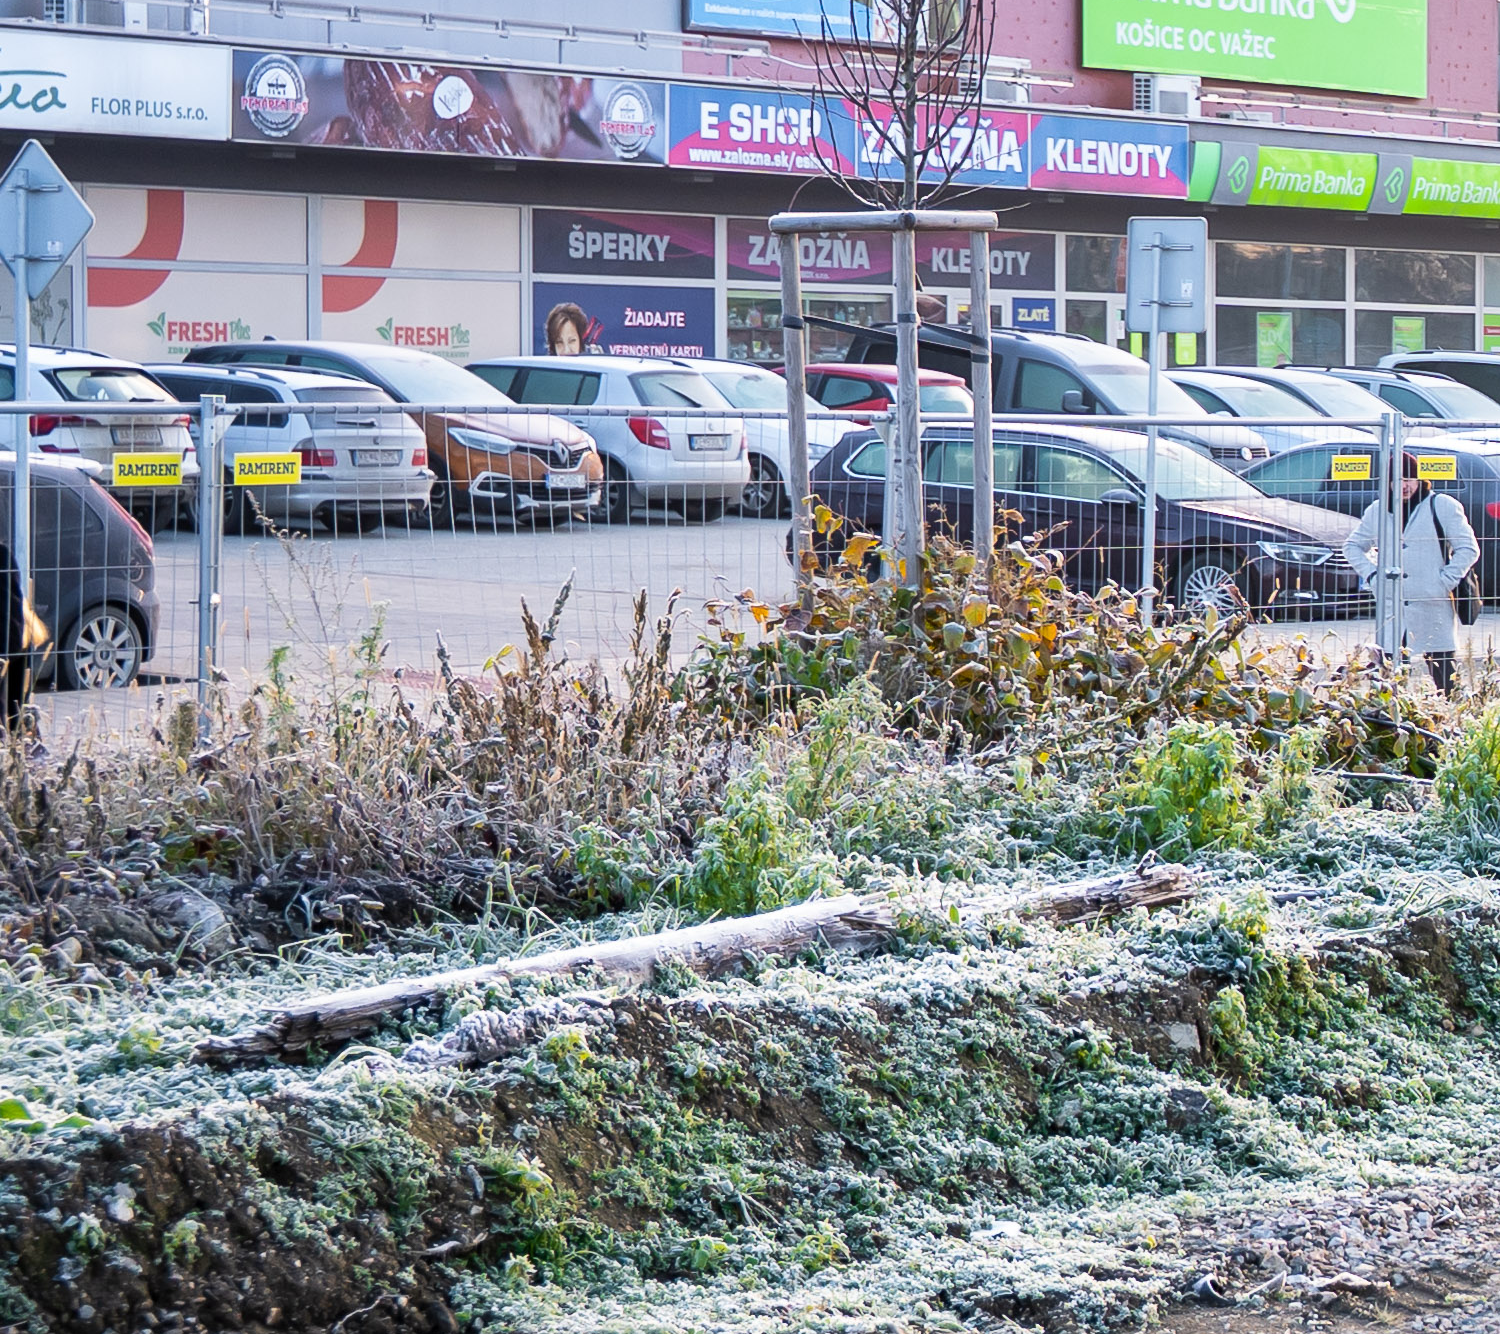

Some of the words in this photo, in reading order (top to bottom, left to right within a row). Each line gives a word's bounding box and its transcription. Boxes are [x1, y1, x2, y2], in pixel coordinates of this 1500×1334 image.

[1115, 19, 1184, 51] KOŠICE
[1188, 28, 1216, 54] OC
[1219, 29, 1276, 60] VAŽEC
[91, 96, 131, 117] FLOR
[135, 99, 172, 118] PLUS
[175, 105, 209, 121] s.r.o.
[700, 101, 720, 140] E
[729, 102, 822, 146] SHOP
[1045, 137, 1173, 179] KLENOTY
[1258, 166, 1312, 192] Prima
[1312, 169, 1367, 197] Banka
[1412, 176, 1461, 202] Prima
[568, 223, 671, 262] ŠPERKY
[931, 246, 1031, 276] KLEOTY
[624, 308, 686, 327] ŽIADAJTE
[1017, 305, 1050, 322] ZLATÉ
[167, 321, 228, 343] FRESH
[394, 326, 449, 346] FRESH
[118, 462, 179, 477] RAMIRENT
[238, 461, 297, 475] RAMIRENT
